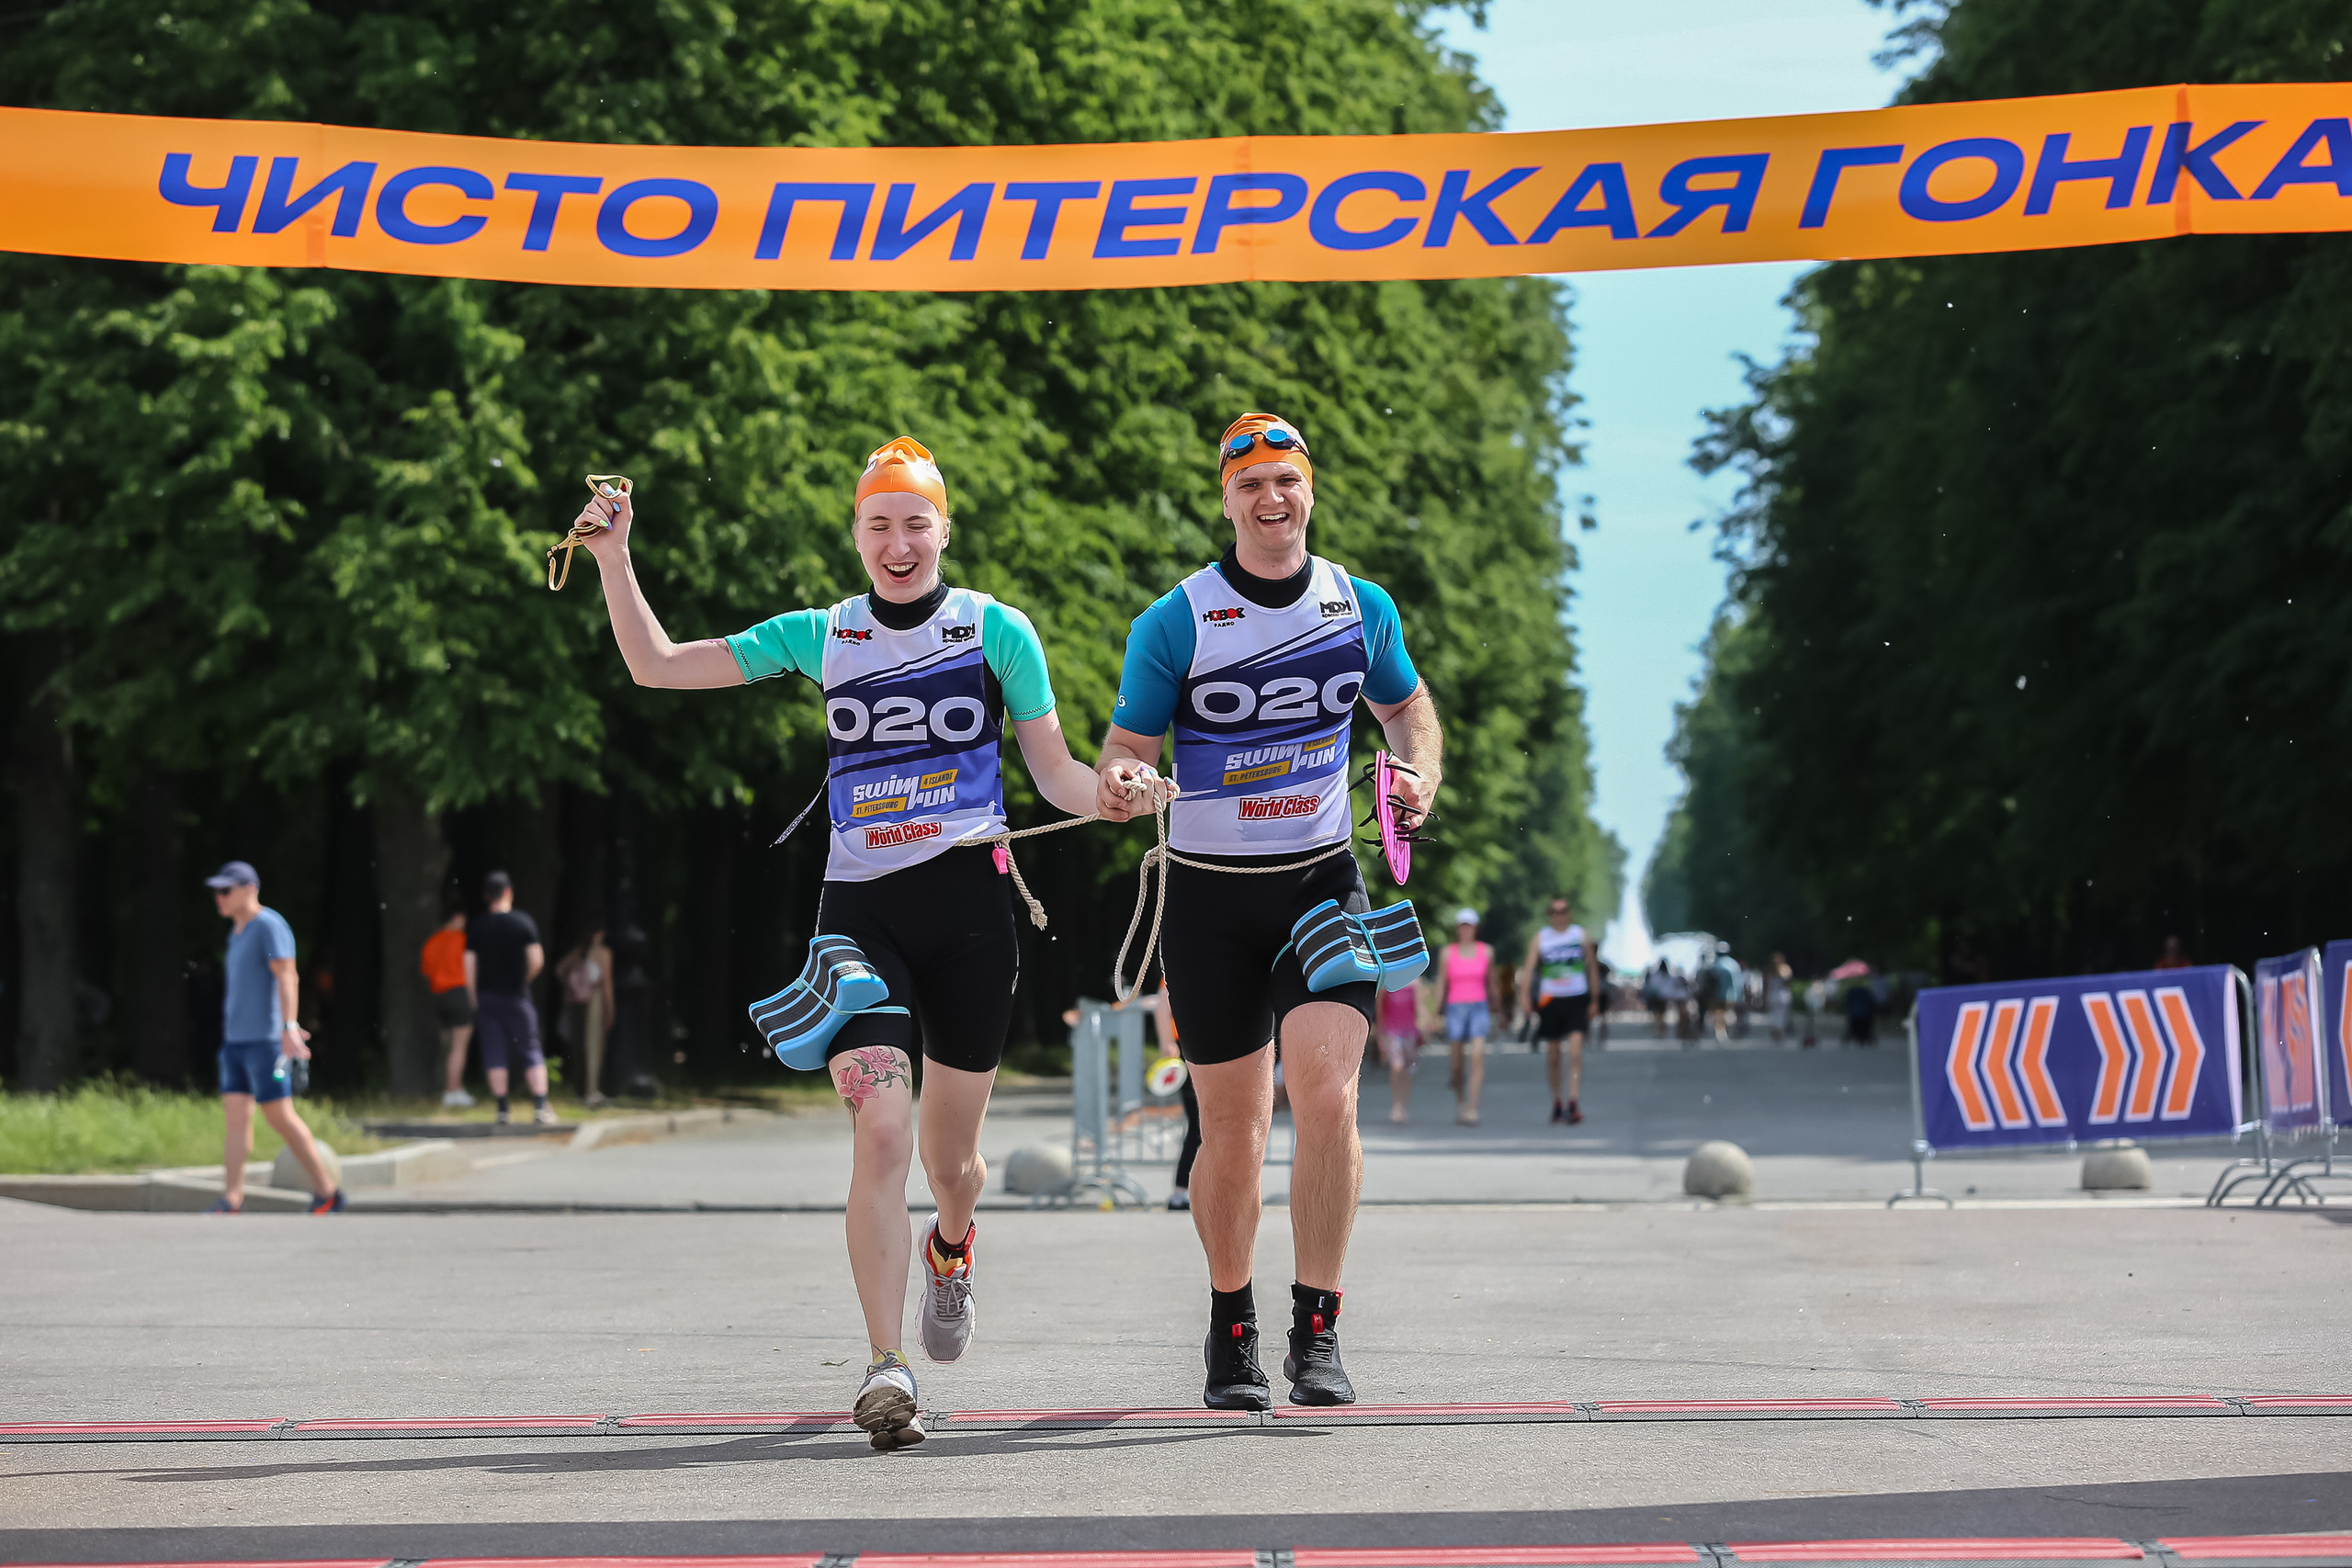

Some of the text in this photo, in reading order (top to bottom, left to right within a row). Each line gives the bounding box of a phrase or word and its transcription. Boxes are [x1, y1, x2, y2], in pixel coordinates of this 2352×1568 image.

[158, 118, 2352, 260] ЧИСТО ПИТЕРСКАЯ ГОНКА
[1191, 671, 1365, 723] 020
[826, 695, 985, 742] 020
[928, 772, 954, 785] ISLANDS
[1239, 765, 1283, 781] PETERSBURG
[864, 800, 899, 814] PETERSBURG
[1240, 796, 1318, 818] World Class
[868, 821, 939, 846] World Class
